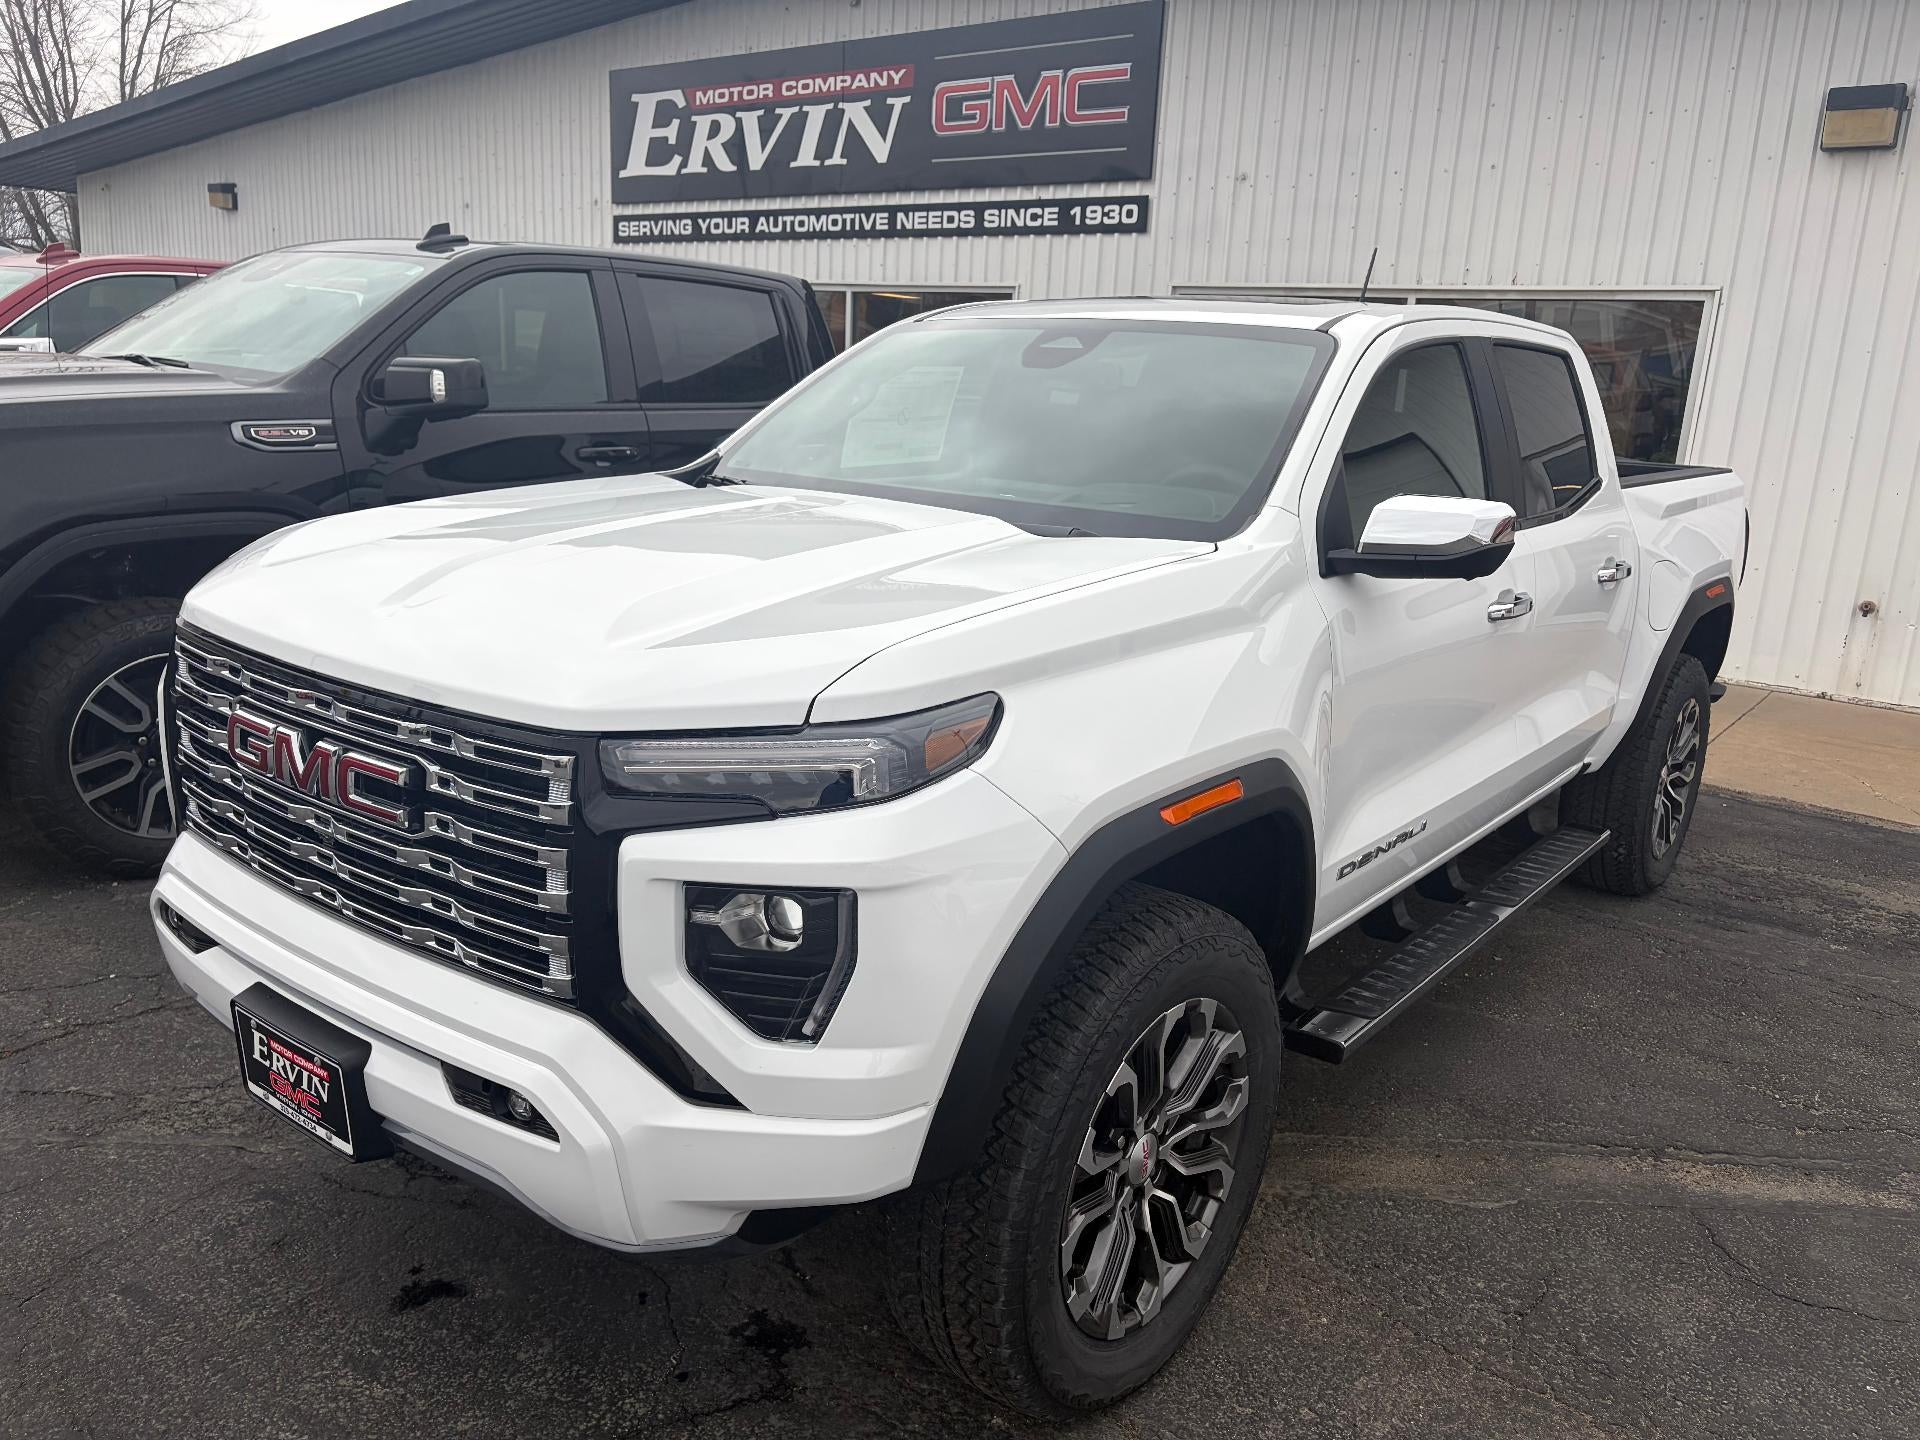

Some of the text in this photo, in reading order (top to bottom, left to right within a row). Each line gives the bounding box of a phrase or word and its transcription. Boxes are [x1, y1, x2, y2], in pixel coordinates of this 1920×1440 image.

[695, 69, 908, 106] MOTOR COMPANY
[931, 62, 1133, 136] GMC
[618, 89, 912, 179] ERVIN
[617, 204, 1139, 237] SERVING YOUR AUTOMOTIVE NEEDS SINCE 1930
[227, 709, 409, 828] GMC
[1335, 819, 1428, 882] DENALI
[251, 1028, 330, 1104] ERVIN
[269, 1039, 329, 1080] MOTOR COMPANY
[269, 1071, 322, 1119] GMC
[1139, 1138, 1150, 1179] GMC
